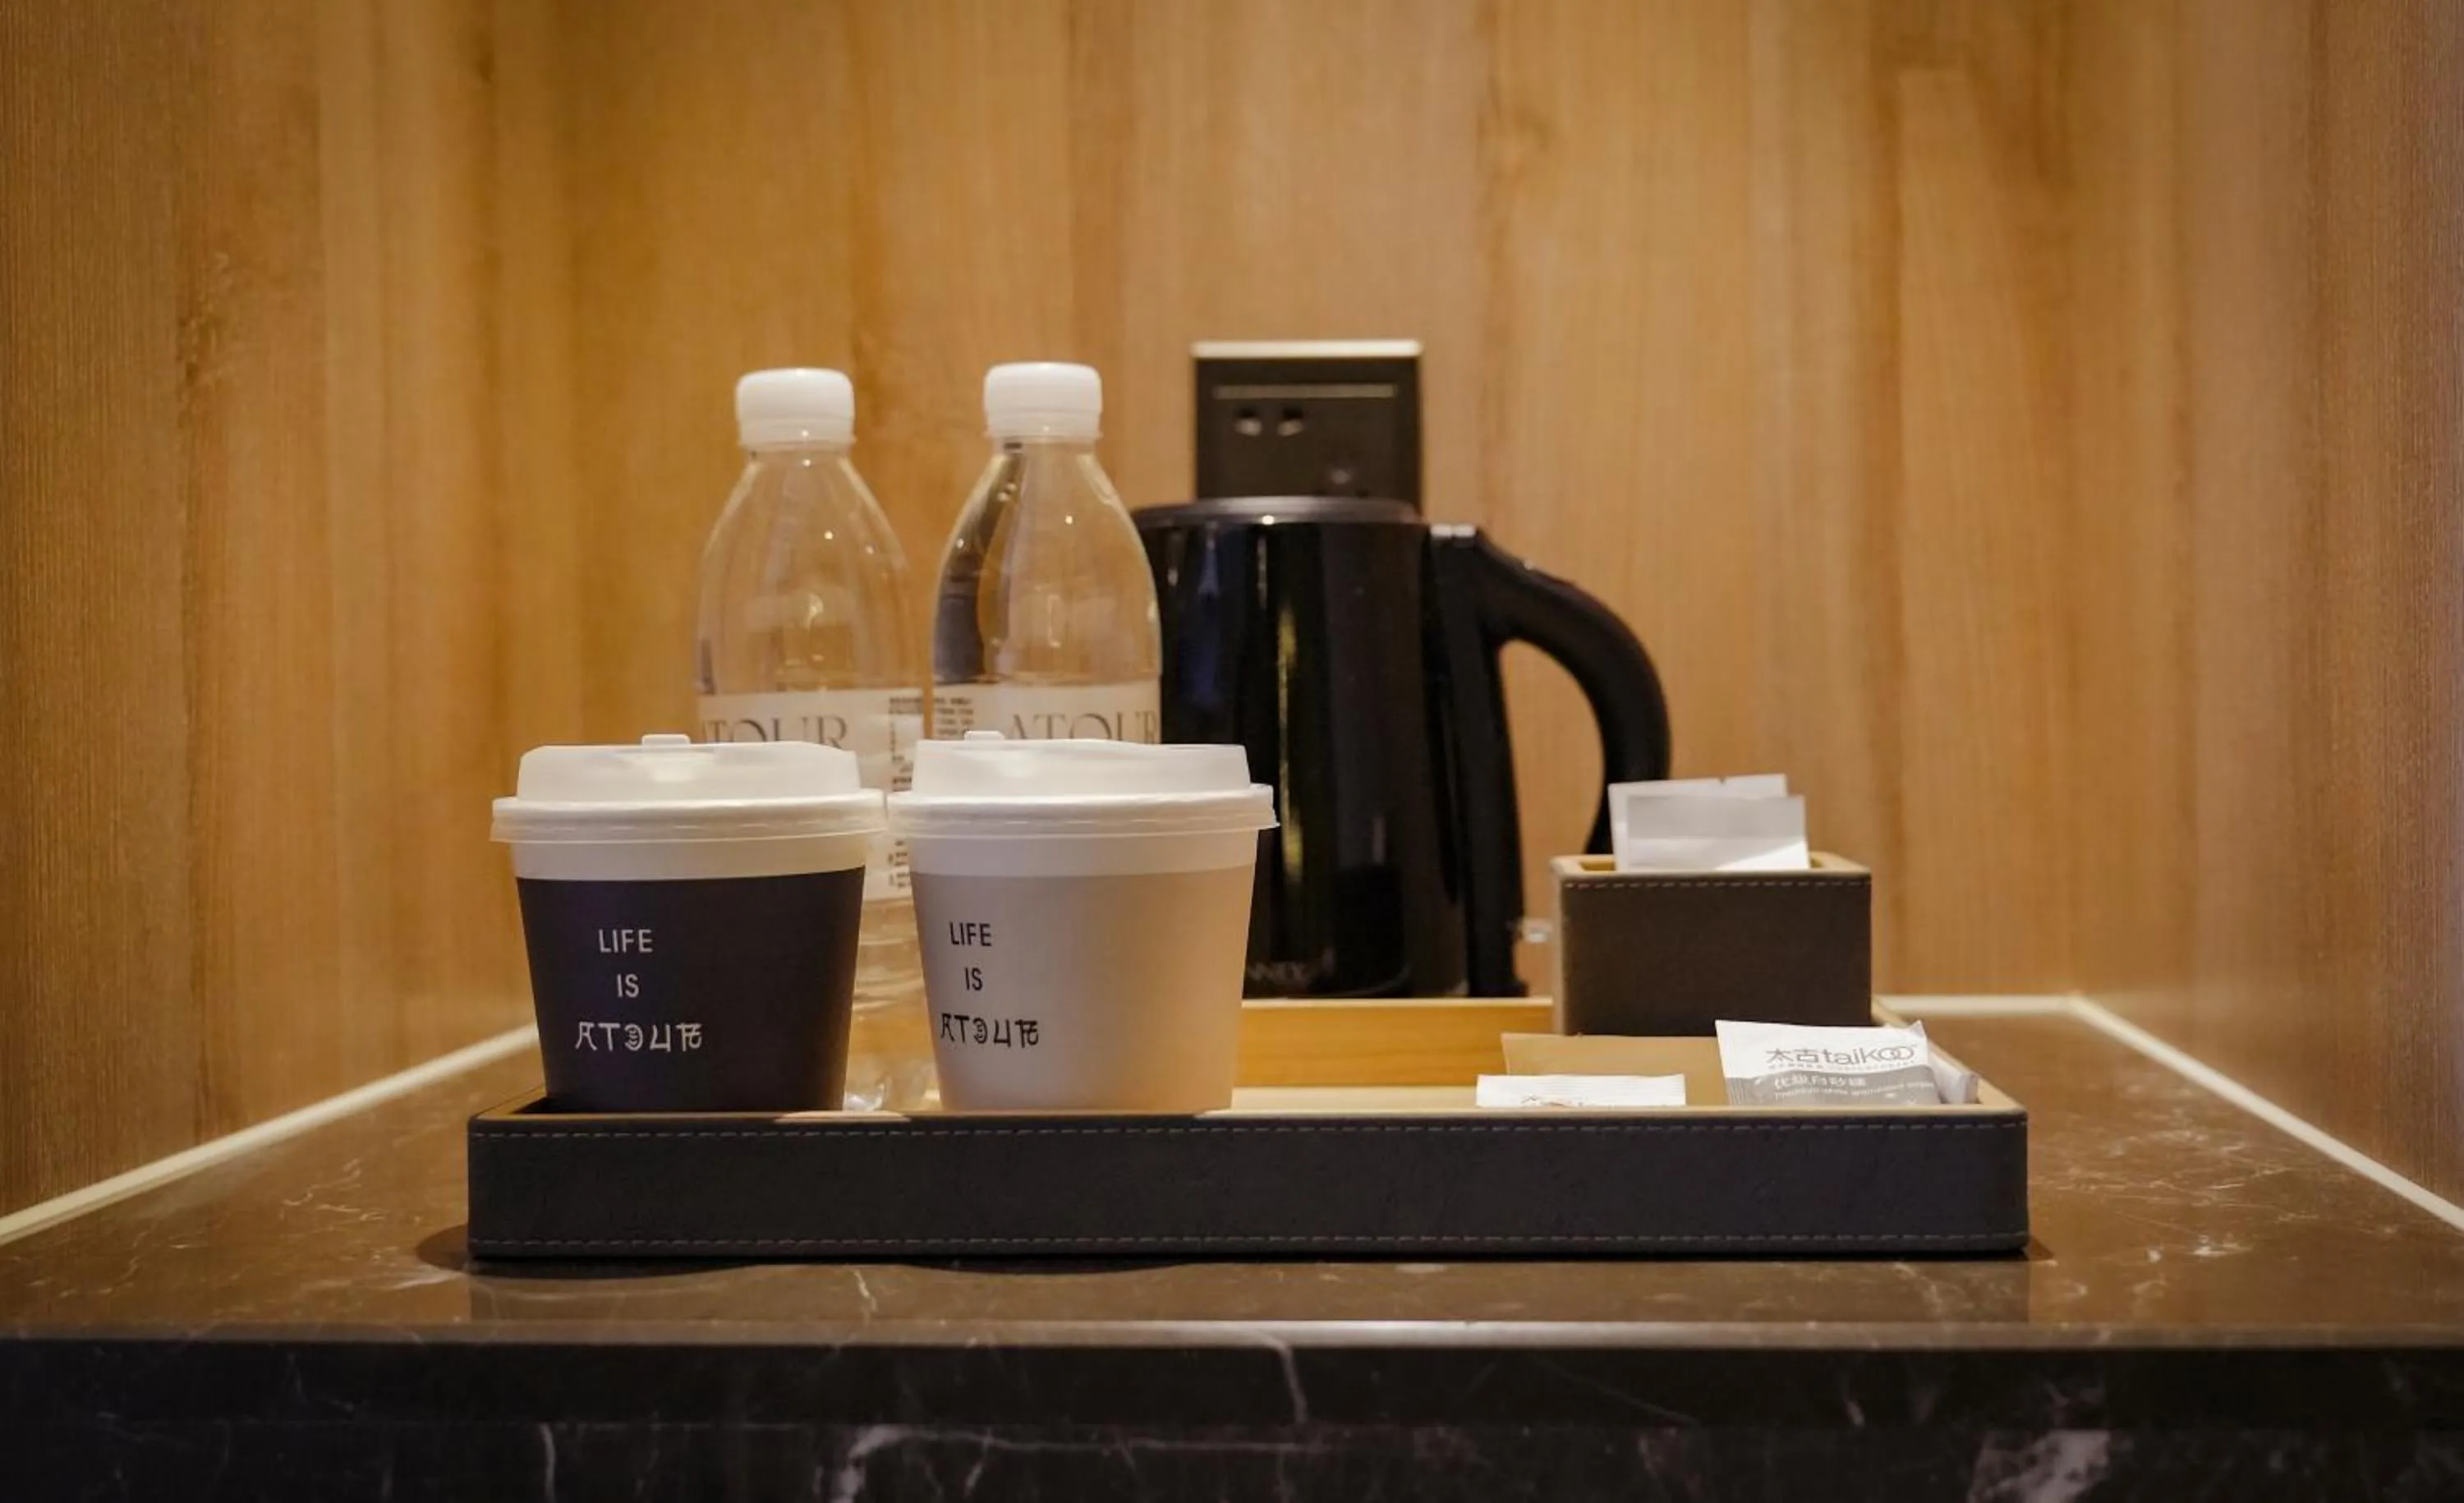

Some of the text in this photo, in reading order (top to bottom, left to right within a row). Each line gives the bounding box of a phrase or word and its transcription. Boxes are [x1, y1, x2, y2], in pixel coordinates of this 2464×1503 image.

[598, 928, 654, 954] LIFE
[949, 922, 992, 947] LIFE
[617, 973, 640, 998] IS
[964, 967, 983, 991] IS
